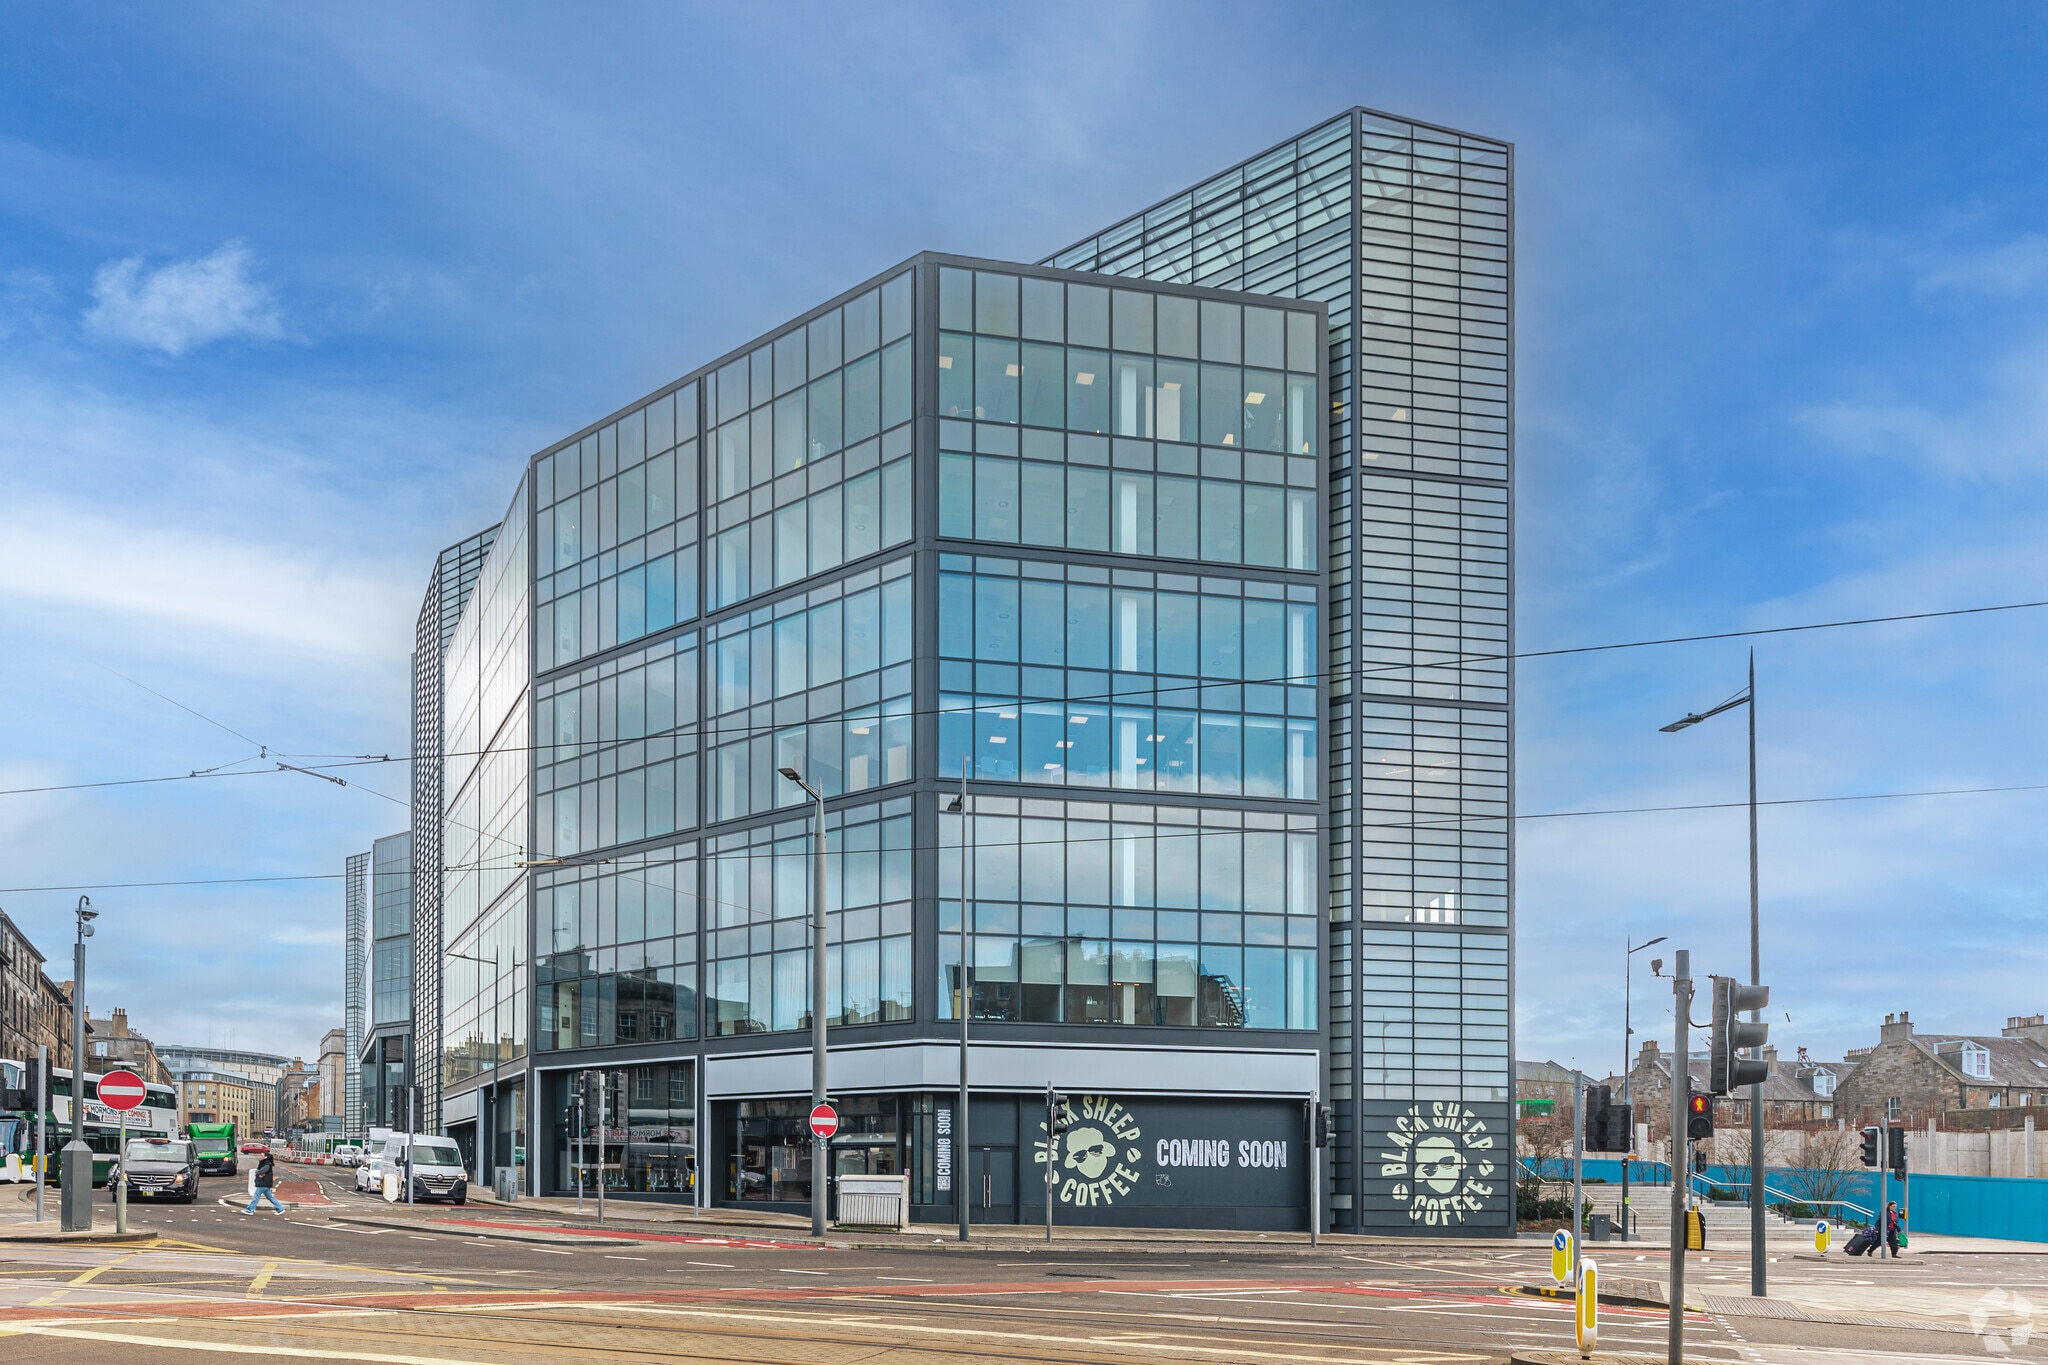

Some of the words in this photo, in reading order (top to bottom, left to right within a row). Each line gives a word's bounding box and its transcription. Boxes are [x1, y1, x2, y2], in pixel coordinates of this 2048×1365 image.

[937, 1109, 951, 1135] SOON
[1034, 1099, 1079, 1163] BLK
[1082, 1095, 1141, 1141] SHEEP
[1381, 1104, 1430, 1177] BLACK
[1432, 1101, 1494, 1152] SHEEP
[937, 1137, 951, 1176] COMING
[1156, 1138, 1230, 1168] COMING
[1238, 1139, 1287, 1168] SOON
[1060, 1162, 1141, 1207] COFFEE
[1408, 1176, 1494, 1226] COFFEE
